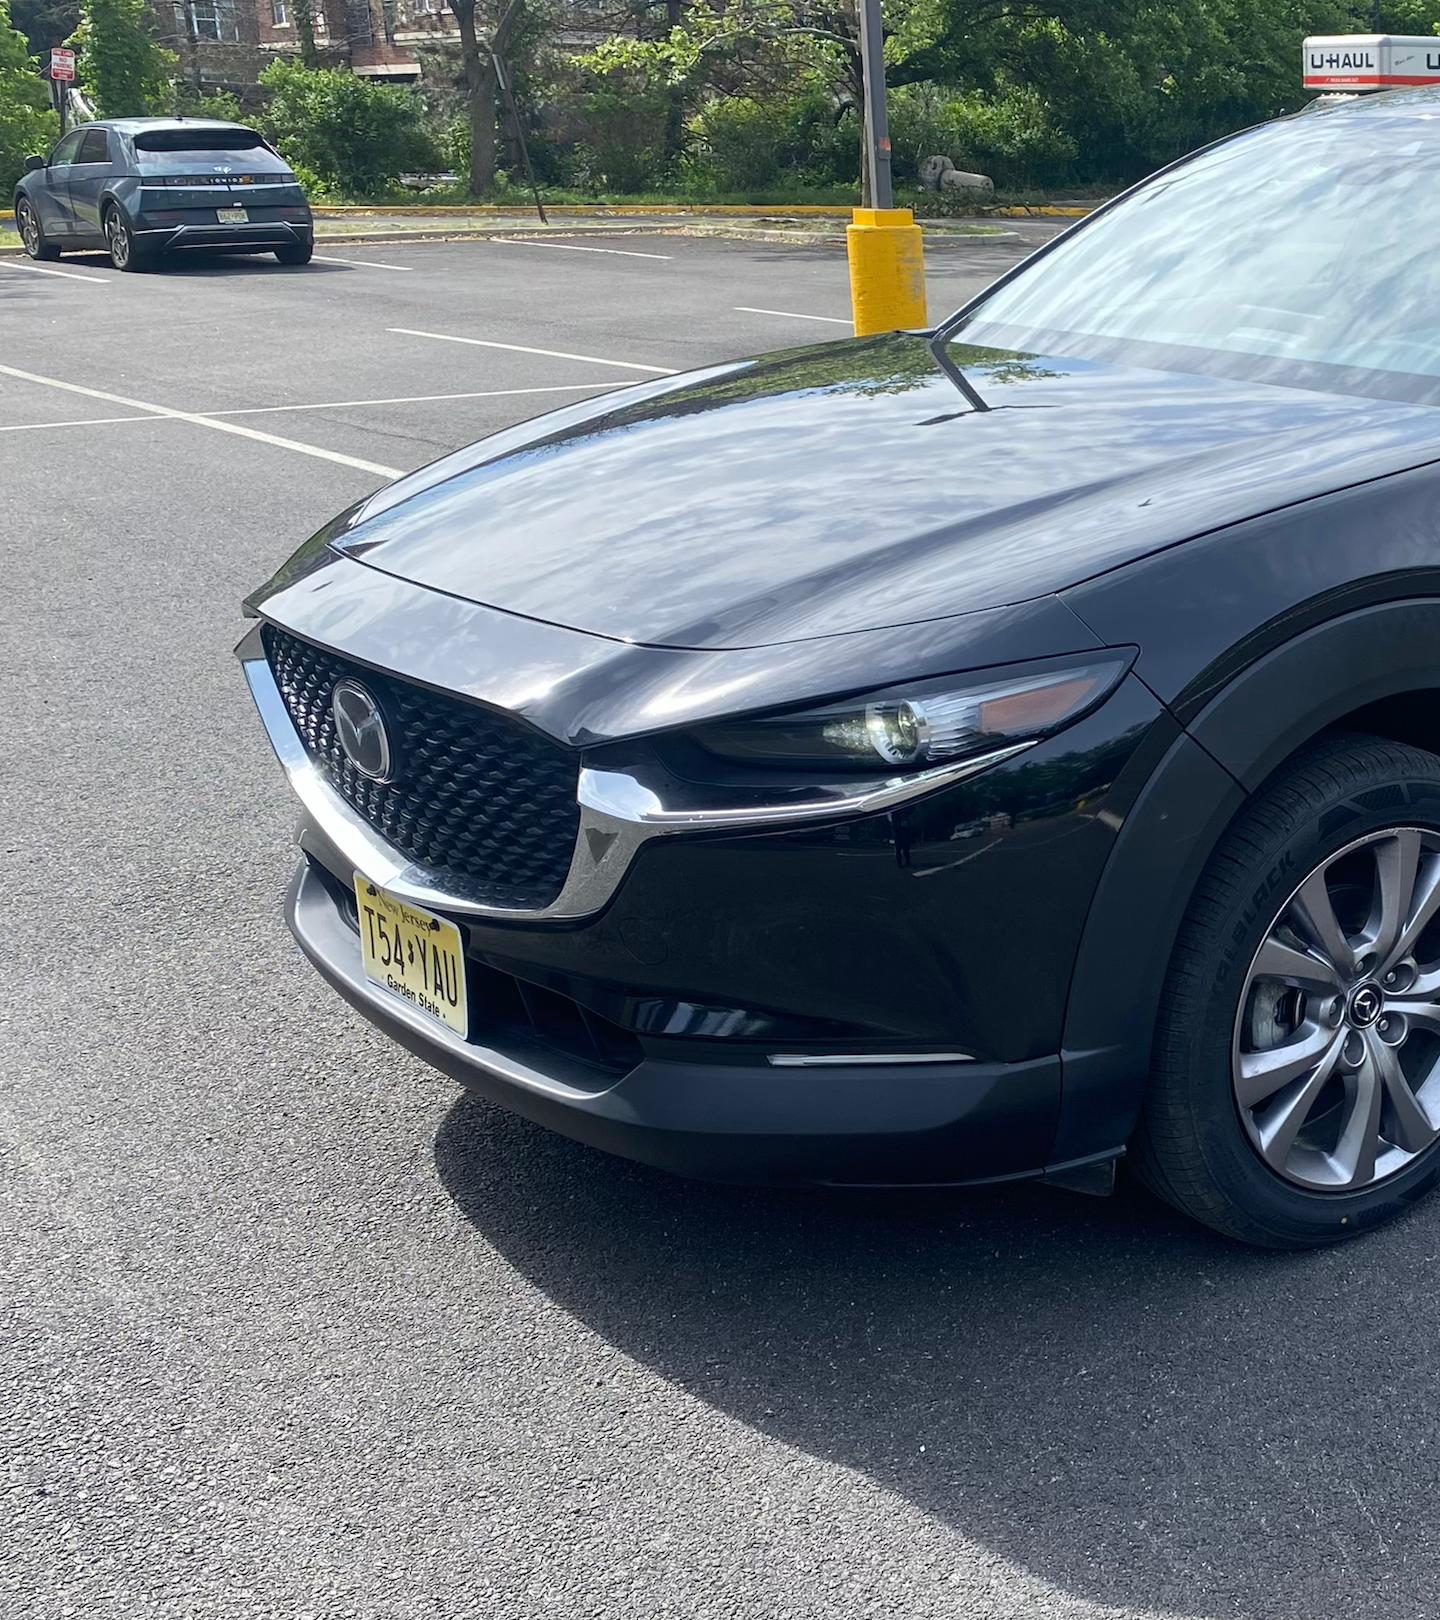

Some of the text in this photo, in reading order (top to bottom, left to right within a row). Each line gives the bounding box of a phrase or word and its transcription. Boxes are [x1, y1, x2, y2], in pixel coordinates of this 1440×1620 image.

[1311, 52, 1374, 69] U-HAUL
[377, 889, 433, 937] New Jersey
[387, 973, 440, 1017] Garden State
